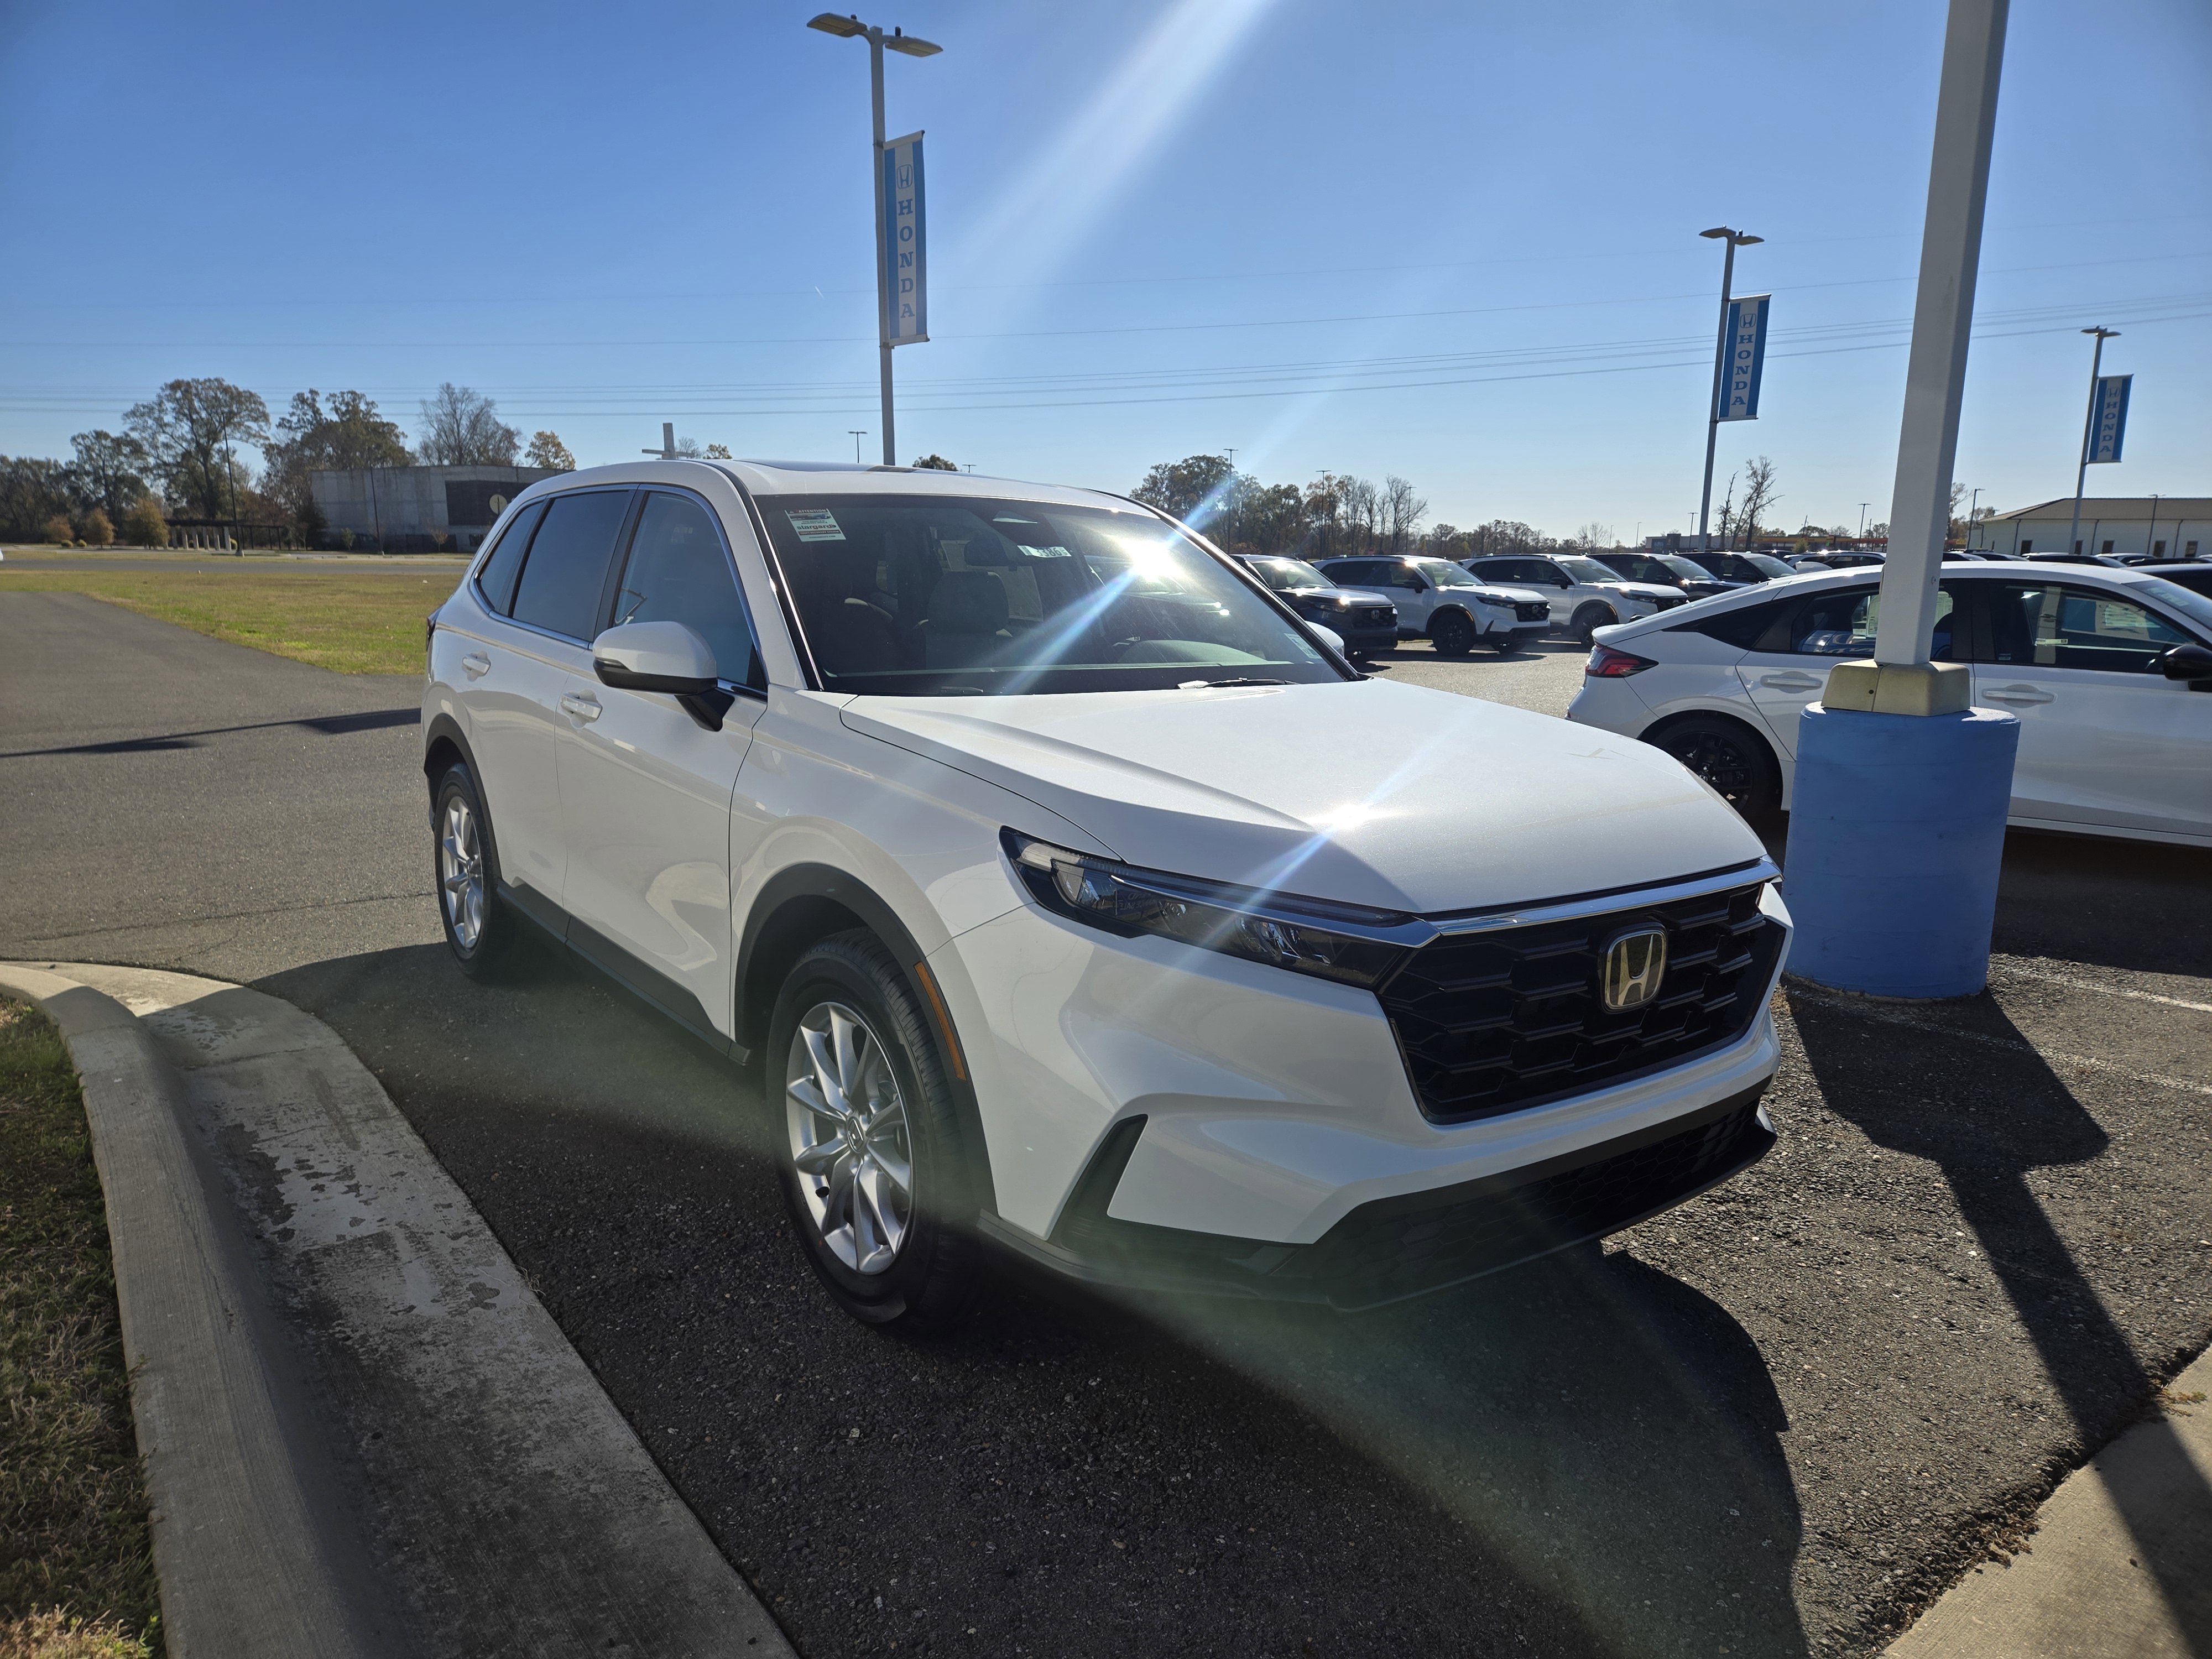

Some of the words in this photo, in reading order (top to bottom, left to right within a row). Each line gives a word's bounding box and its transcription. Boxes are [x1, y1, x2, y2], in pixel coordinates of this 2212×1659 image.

[898, 198, 915, 319] HONDA
[1731, 333, 1754, 405] HONDA
[2099, 401, 2118, 452] HONDA
